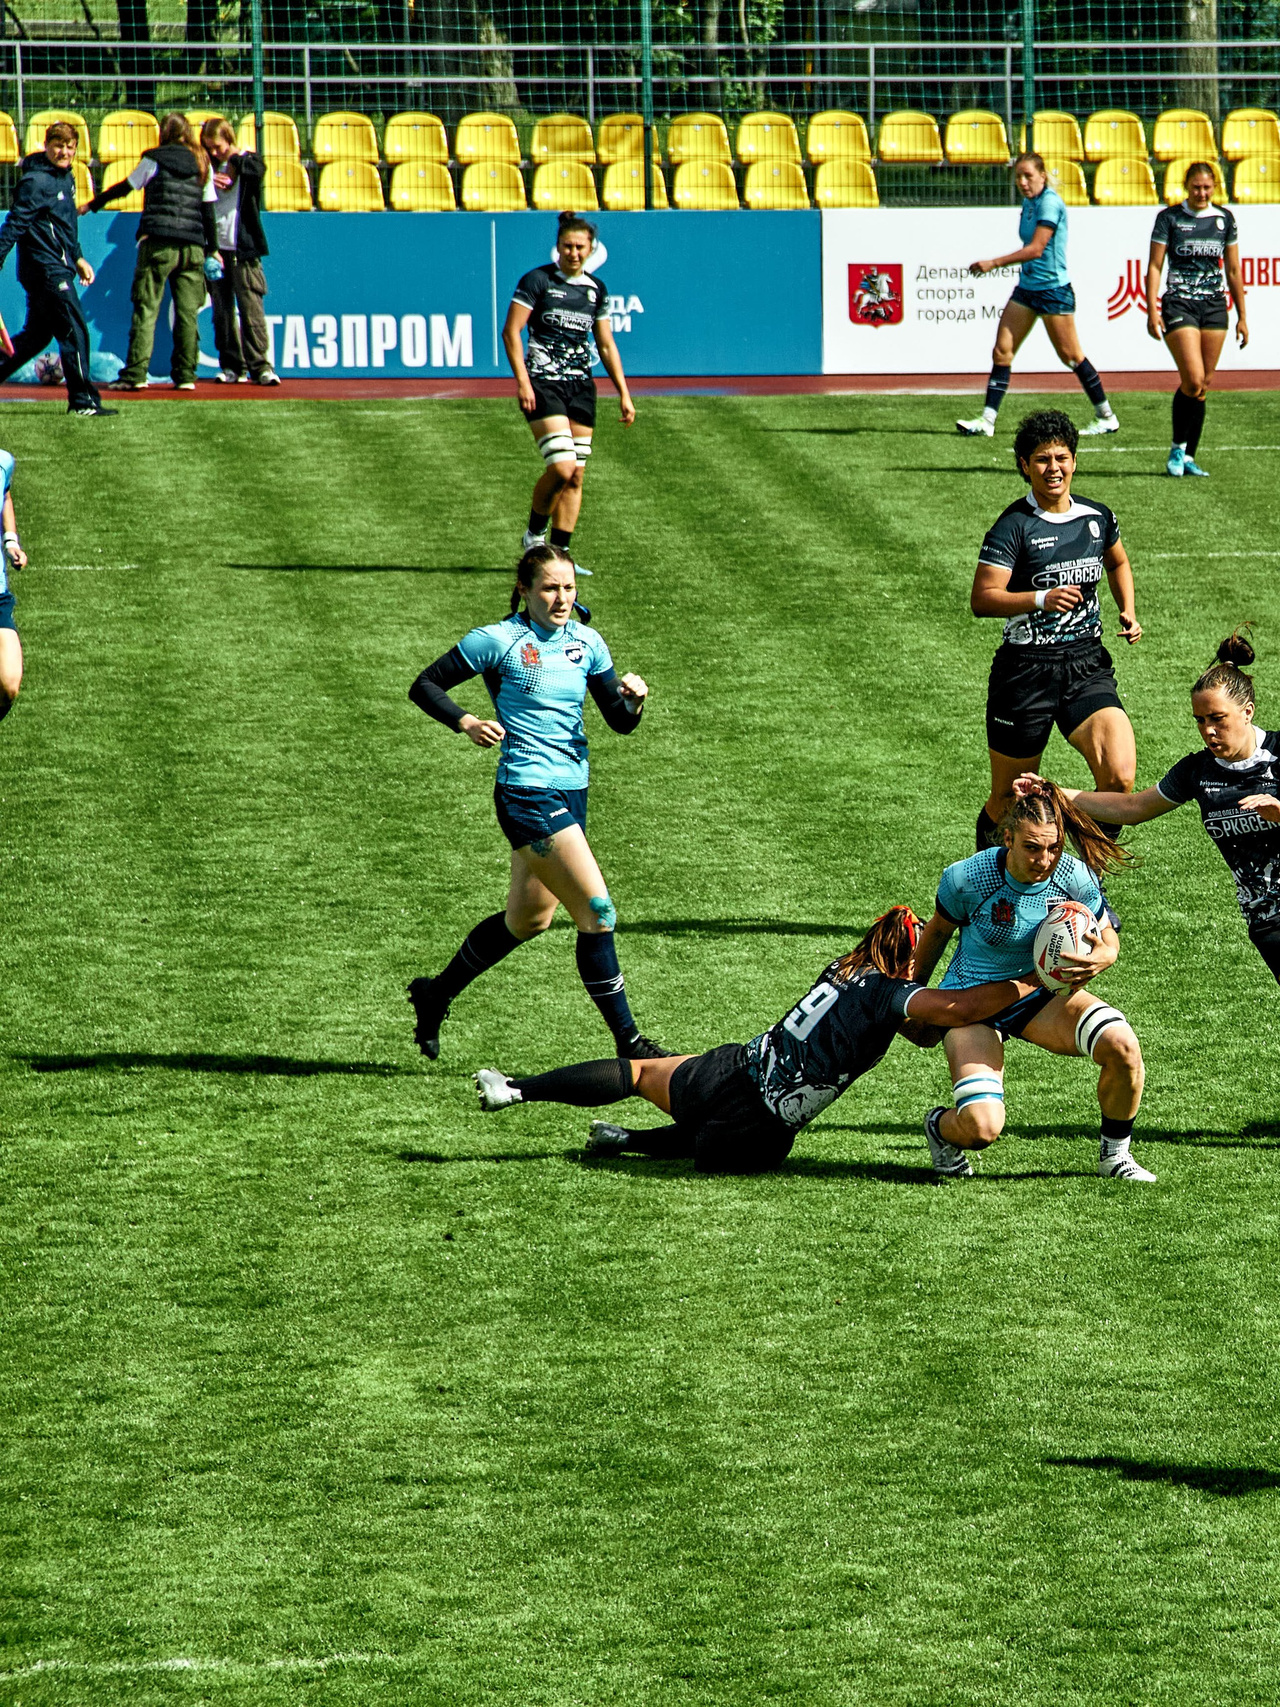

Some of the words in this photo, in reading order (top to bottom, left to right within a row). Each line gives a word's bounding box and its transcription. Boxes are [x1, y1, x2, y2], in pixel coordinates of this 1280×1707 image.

[917, 287, 975, 304] спорта
[917, 308, 976, 325] города
[264, 312, 474, 369] ГАЗПРОМ
[1047, 932, 1058, 958] RUGBY
[1052, 934, 1065, 966] RUSSIAN
[783, 981, 840, 1042] 9
